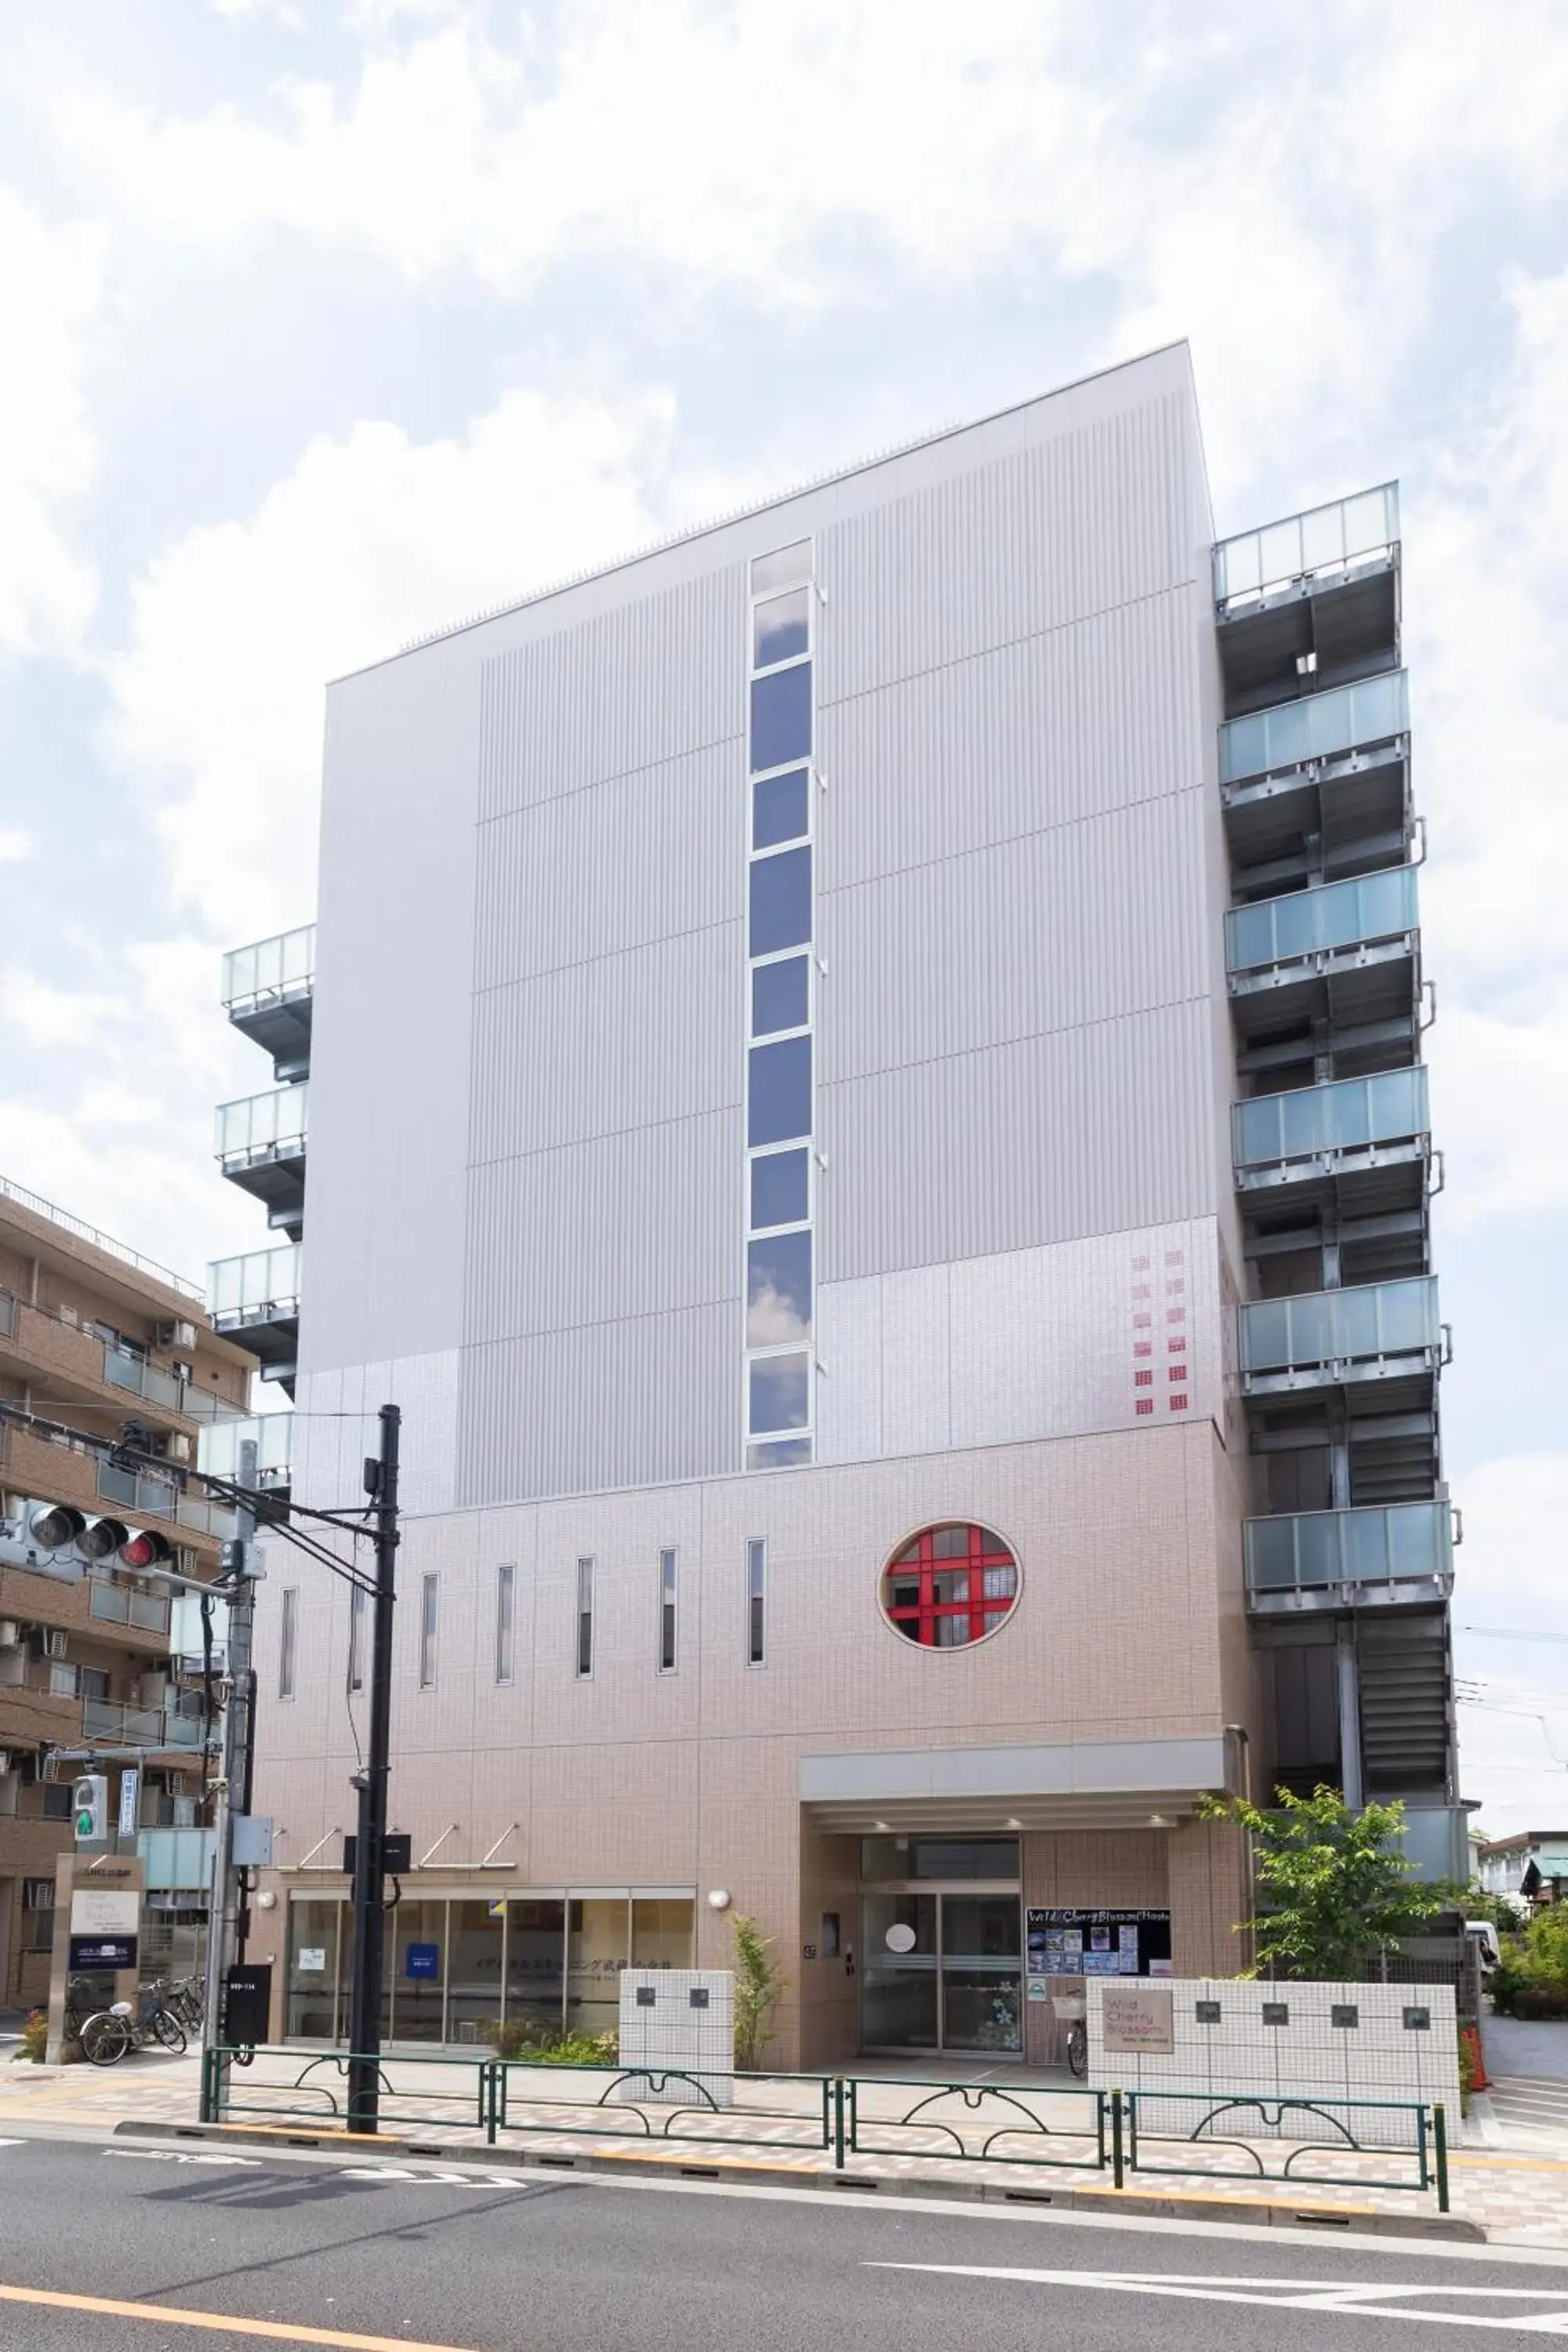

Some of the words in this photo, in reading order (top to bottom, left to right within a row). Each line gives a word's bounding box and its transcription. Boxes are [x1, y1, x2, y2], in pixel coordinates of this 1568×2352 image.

[1105, 1998, 1138, 2010] Wild
[1105, 2011, 1152, 2024] Cherry
[1106, 2023, 1163, 2035] Blossom
